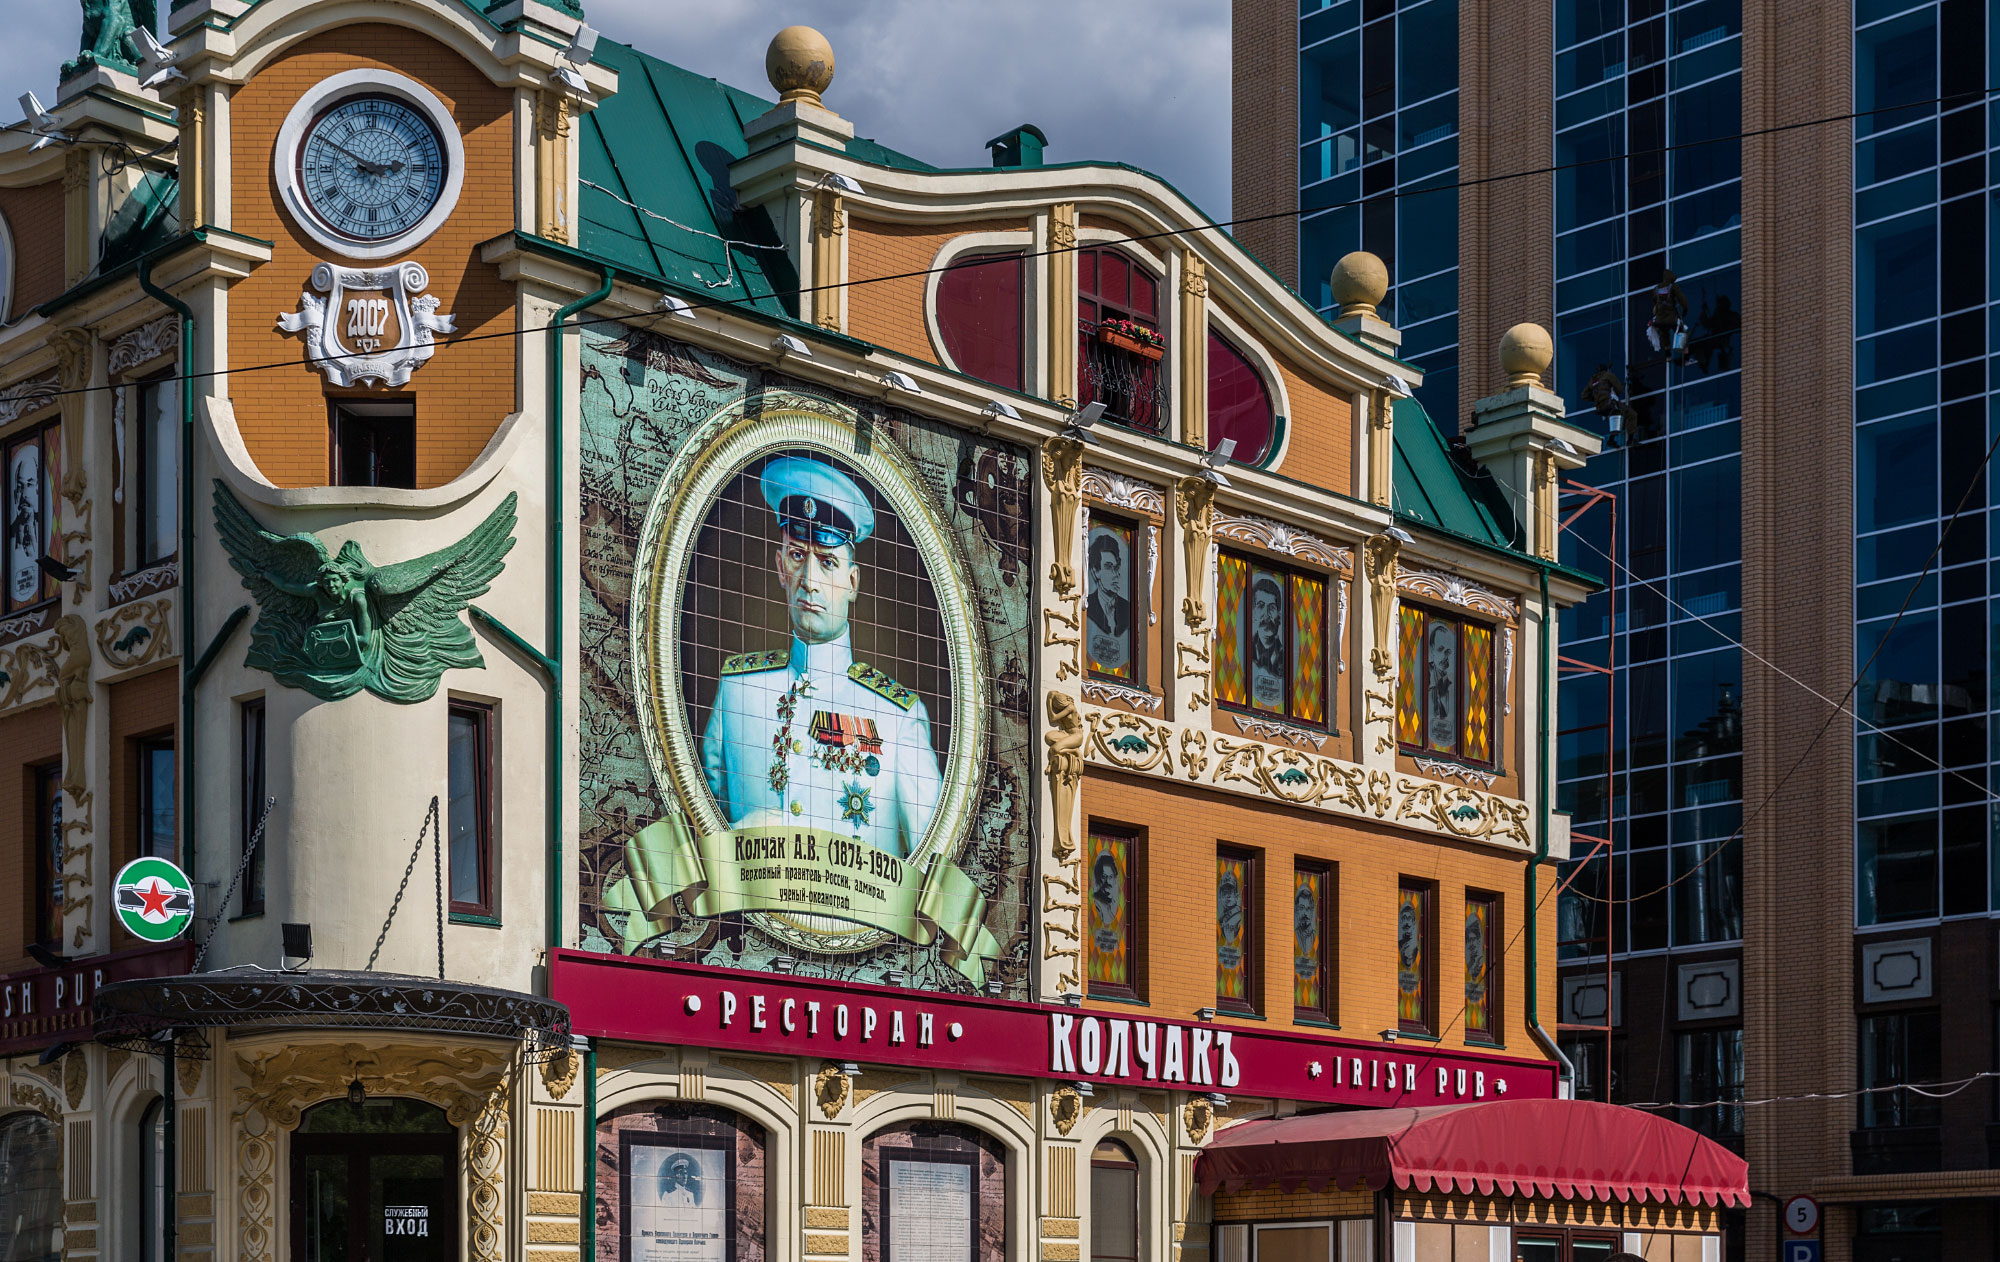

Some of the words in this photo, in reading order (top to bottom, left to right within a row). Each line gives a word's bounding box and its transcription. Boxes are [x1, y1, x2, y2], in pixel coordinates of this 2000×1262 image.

[347, 299, 389, 337] 2007
[735, 836, 786, 861] Колчак
[794, 834, 820, 862] А.В.
[828, 838, 903, 886] (1874-1920)
[740, 864, 782, 881] Верховный
[785, 867, 822, 883] правитель
[825, 869, 851, 890] России,
[855, 878, 887, 902] адмирал,
[779, 888, 850, 910] ученый-океанограф
[56, 968, 103, 1009] PUB
[721, 991, 934, 1045] РЕСТОРАН
[1051, 1013, 1240, 1088] КОЛЧАКЪ
[1335, 1056, 1416, 1091] IRISH
[1437, 1067, 1485, 1097] PUB
[384, 1207, 429, 1217] СЛУЖЕБНЫЙ
[385, 1219, 429, 1237] ВХОД
[1797, 1207, 1807, 1223] 5
